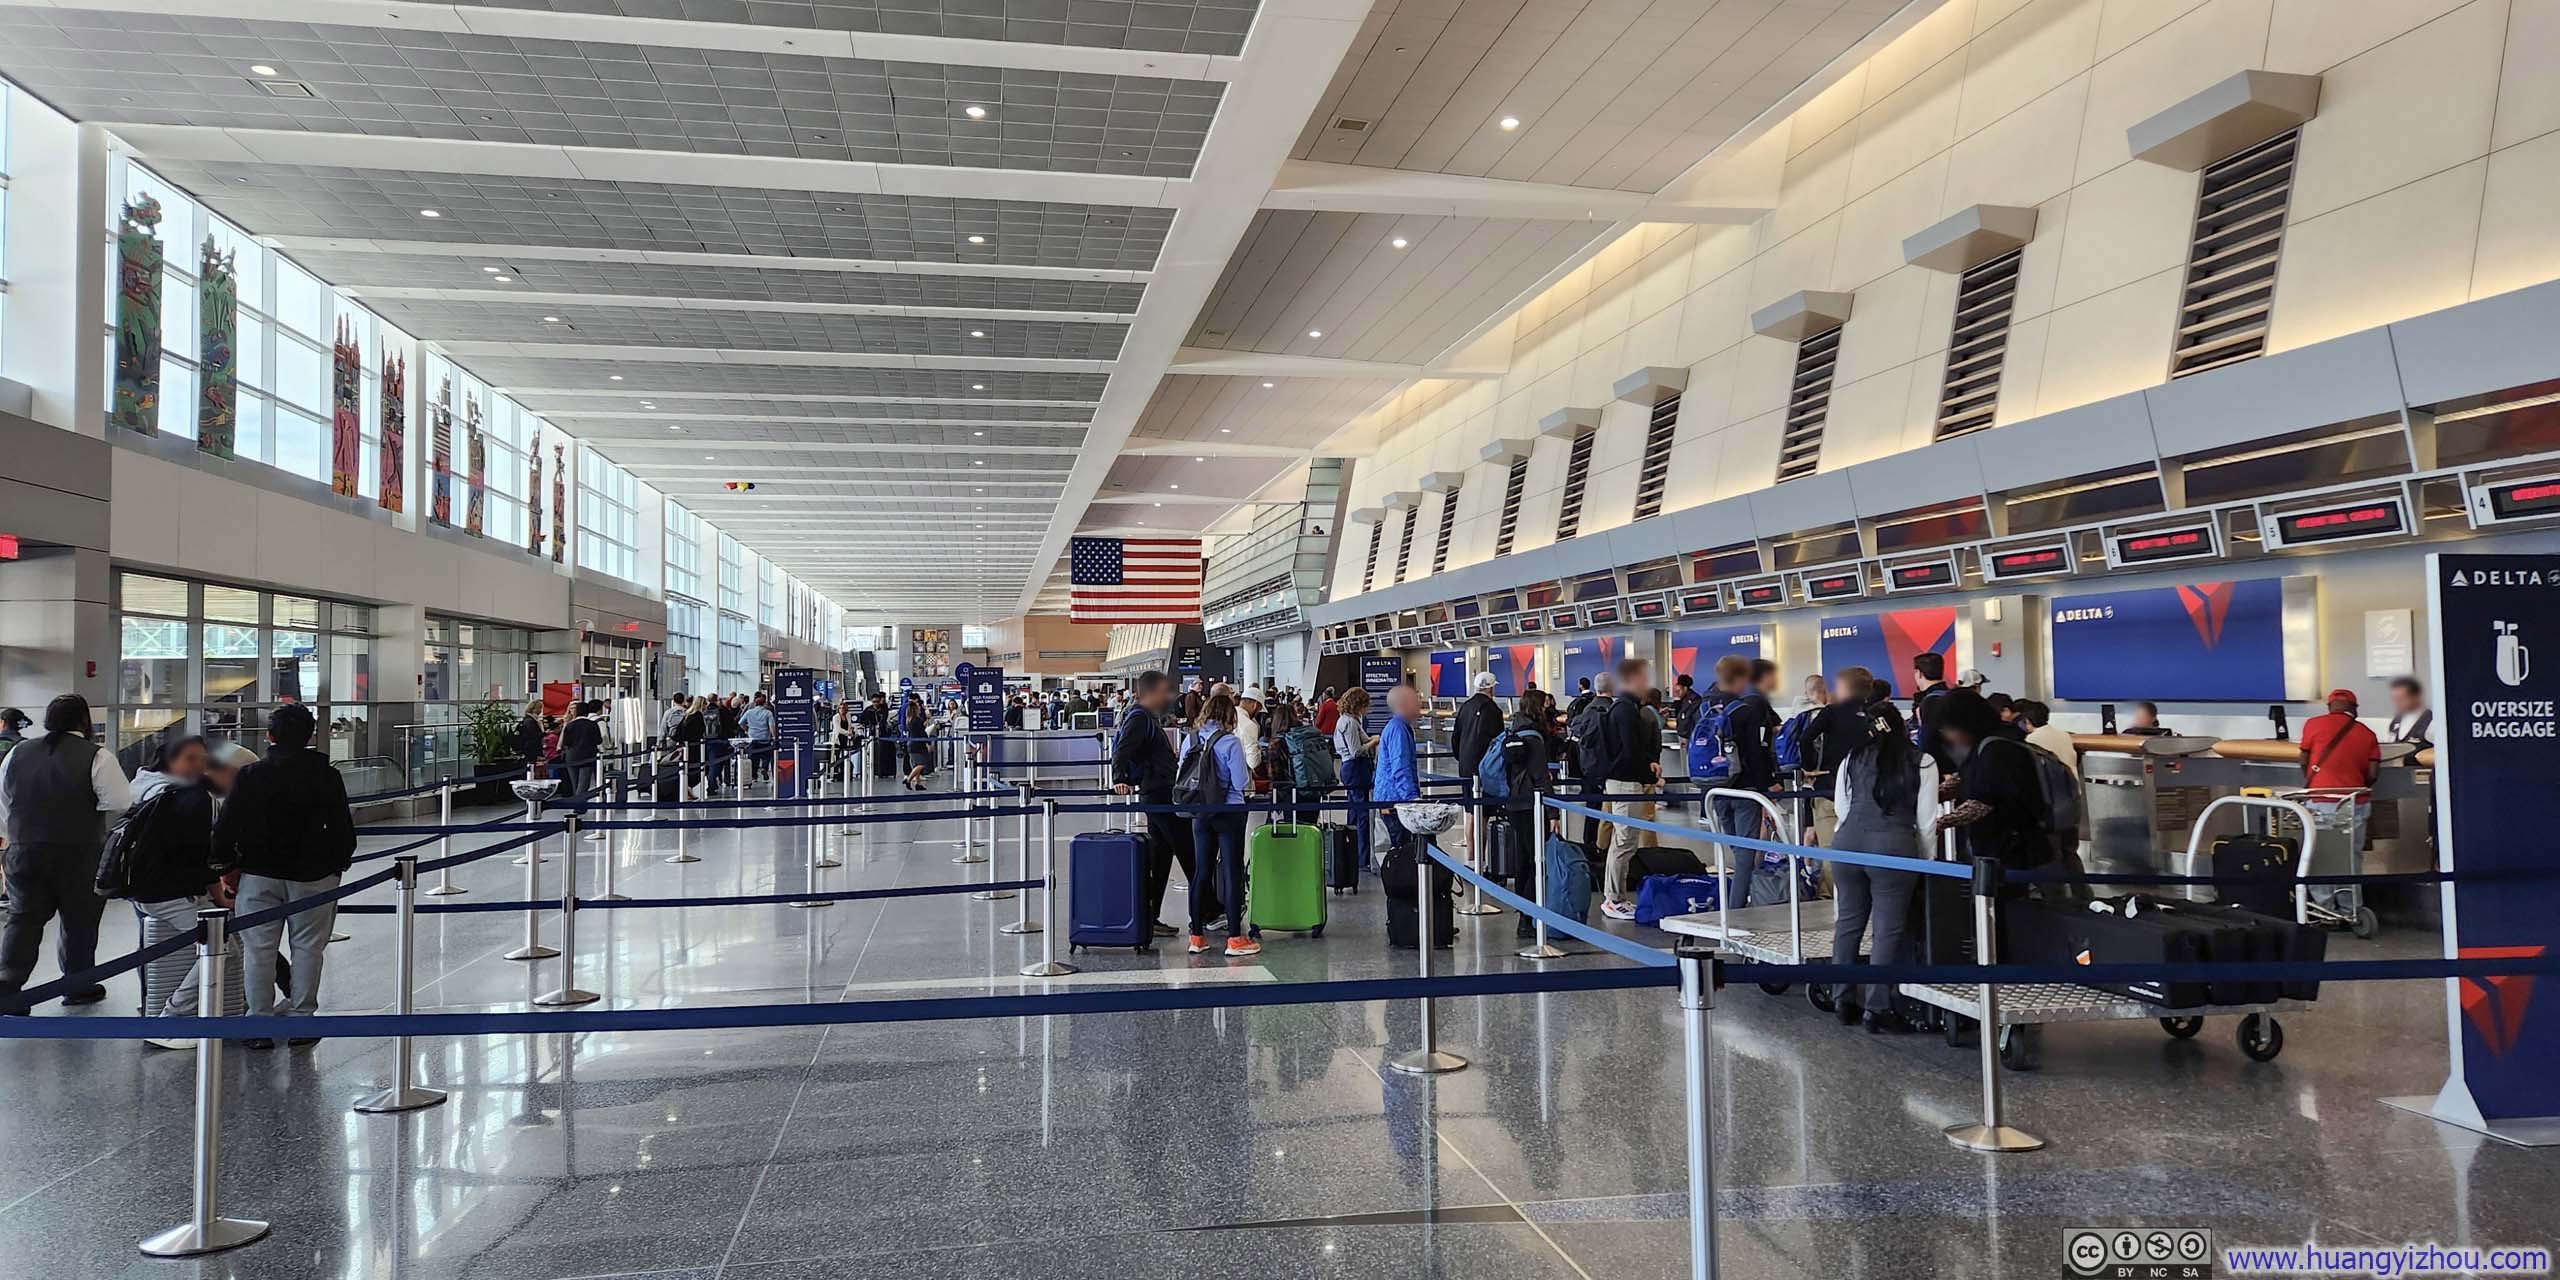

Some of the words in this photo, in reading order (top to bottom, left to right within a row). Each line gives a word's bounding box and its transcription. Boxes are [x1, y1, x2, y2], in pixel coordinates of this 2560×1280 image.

[2479, 497, 2486, 509] 4
[2473, 570, 2542, 585] DELTA
[2066, 607, 2103, 621] DELTA
[1830, 627, 1852, 637] DELTA
[1736, 635, 1754, 644] DELTA
[2471, 701, 2554, 718] OVERSIZE
[2472, 721, 2556, 738] BAGGAGE
